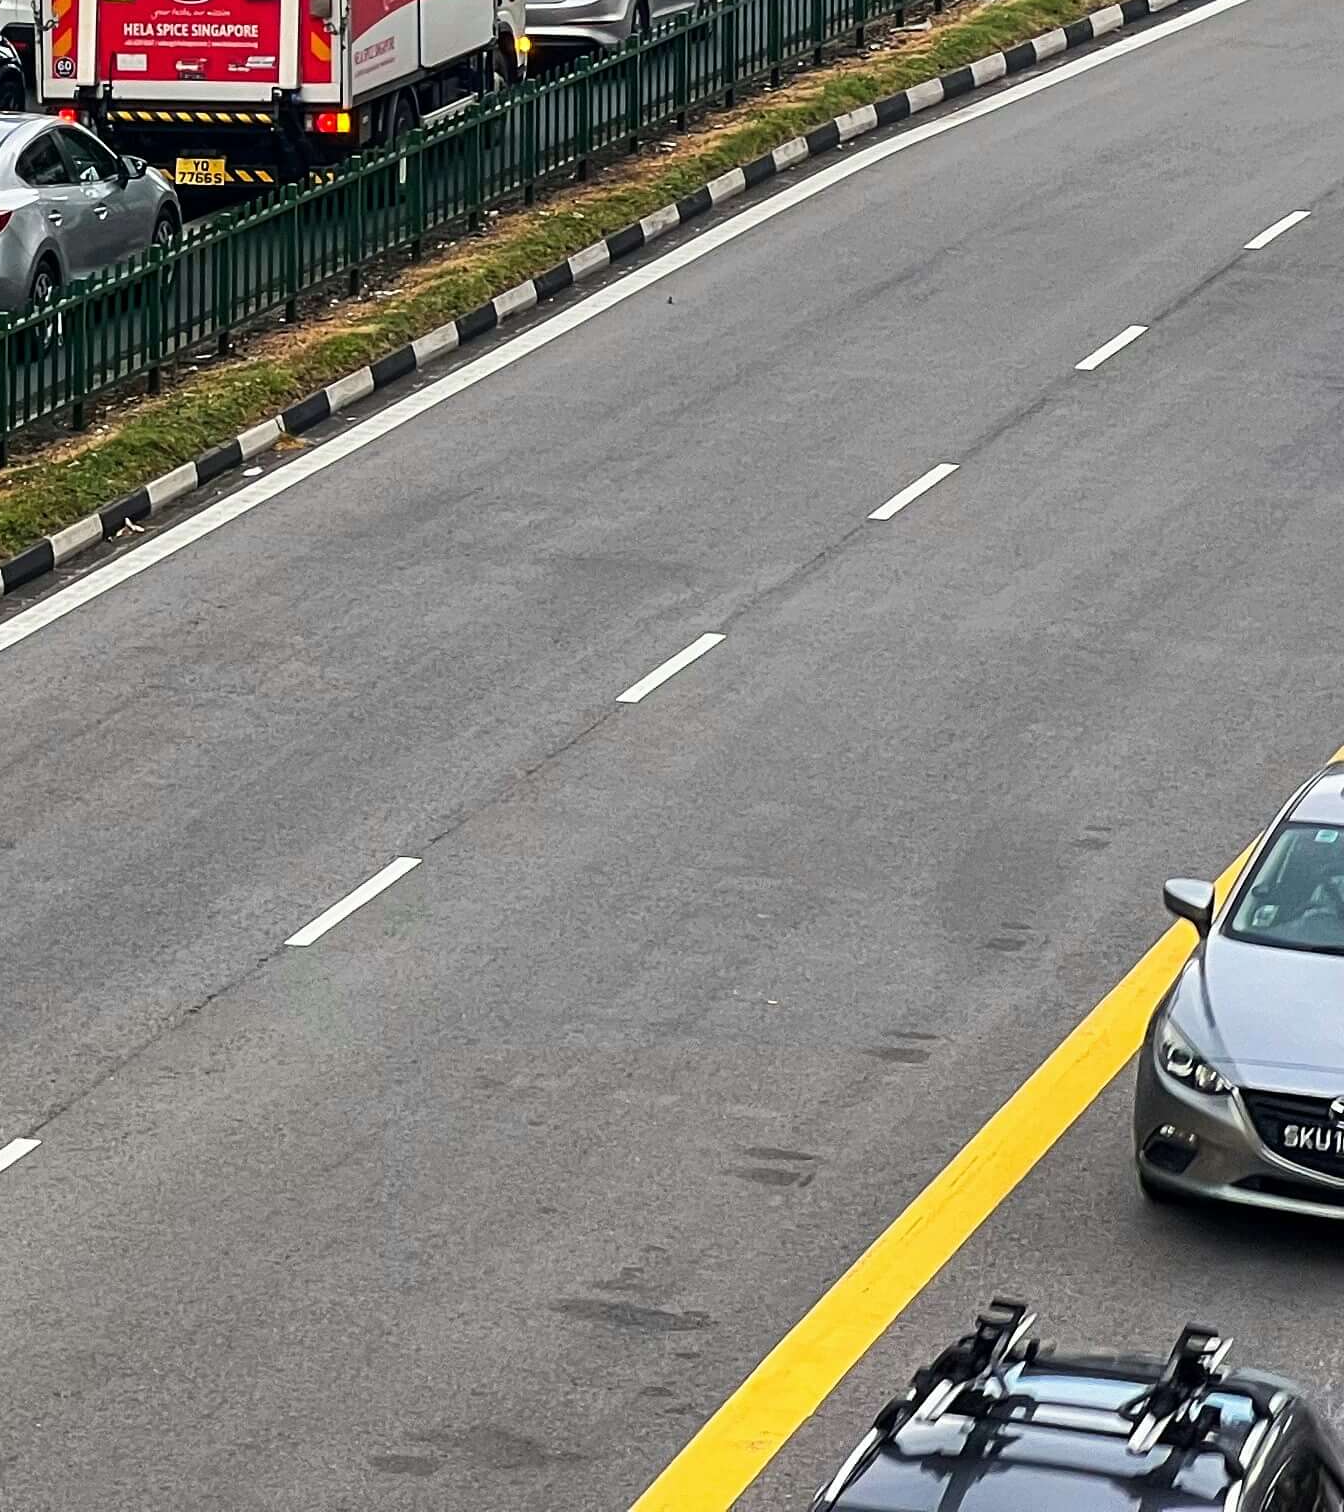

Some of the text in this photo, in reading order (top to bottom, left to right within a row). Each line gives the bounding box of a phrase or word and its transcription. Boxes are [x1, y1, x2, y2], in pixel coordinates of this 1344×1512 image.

[123, 23, 259, 39] HELA SPICE SINGAPORE
[57, 60, 73, 71] 60
[1284, 1124, 1344, 1153] SKU1
